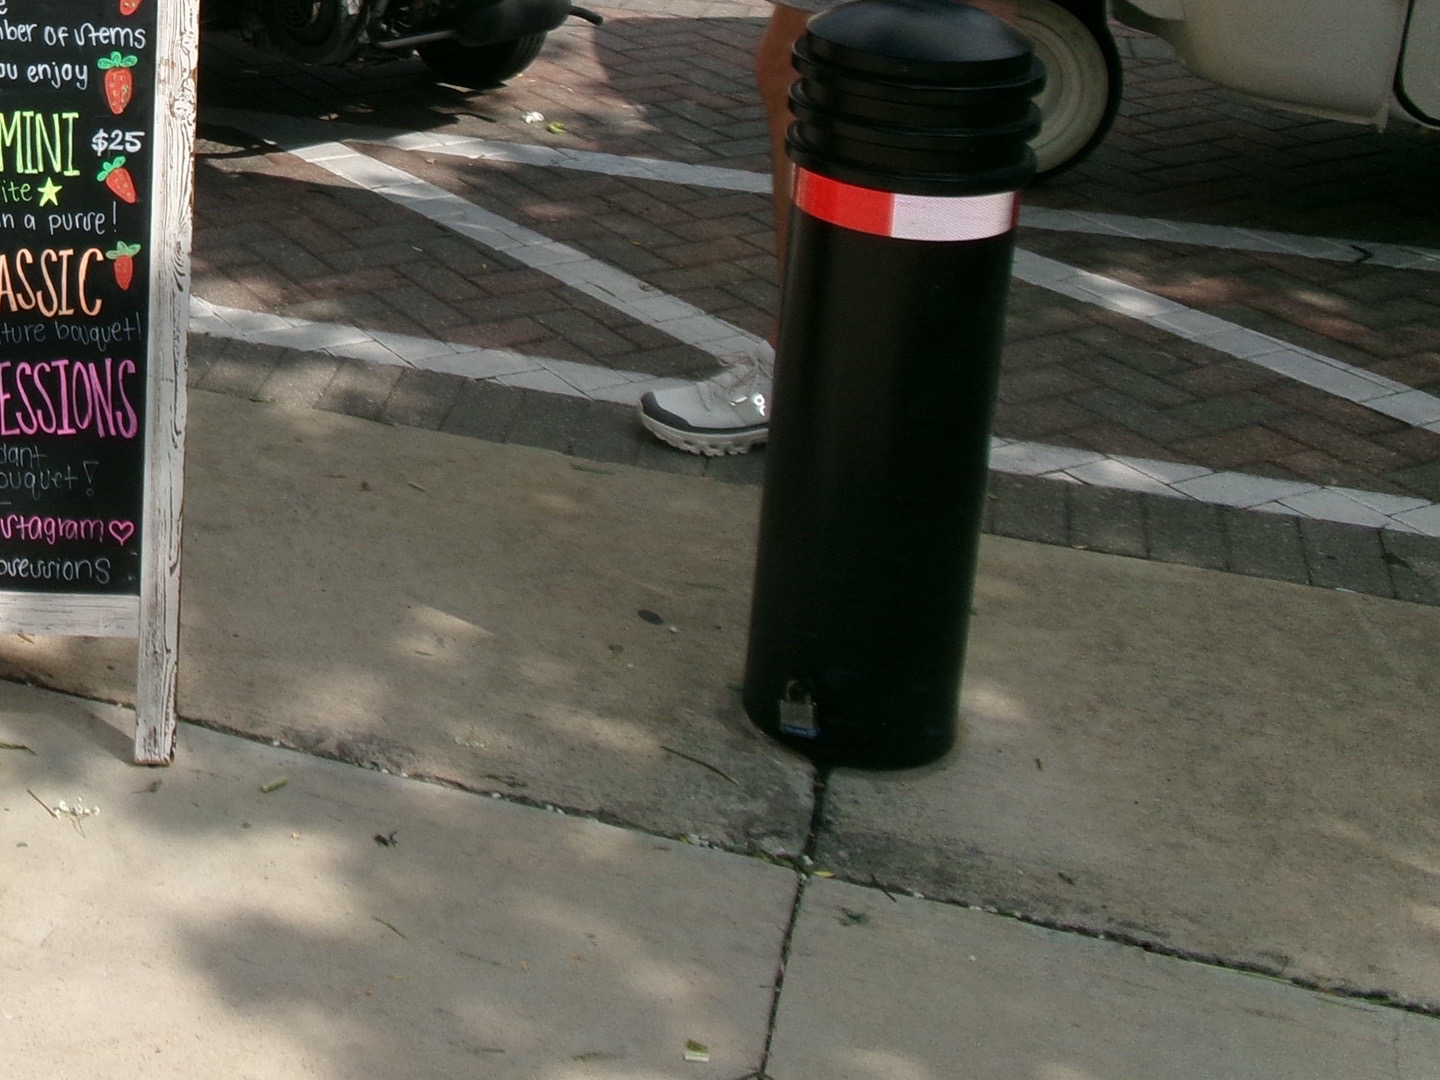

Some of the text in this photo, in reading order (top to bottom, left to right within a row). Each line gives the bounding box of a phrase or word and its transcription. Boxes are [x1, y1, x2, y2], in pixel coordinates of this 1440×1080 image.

[44, 25, 69, 48] of
[74, 22, 147, 50] stems
[26, 61, 89, 90] enjoy
[91, 128, 146, 157] $25
[23, 215, 37, 232] a
